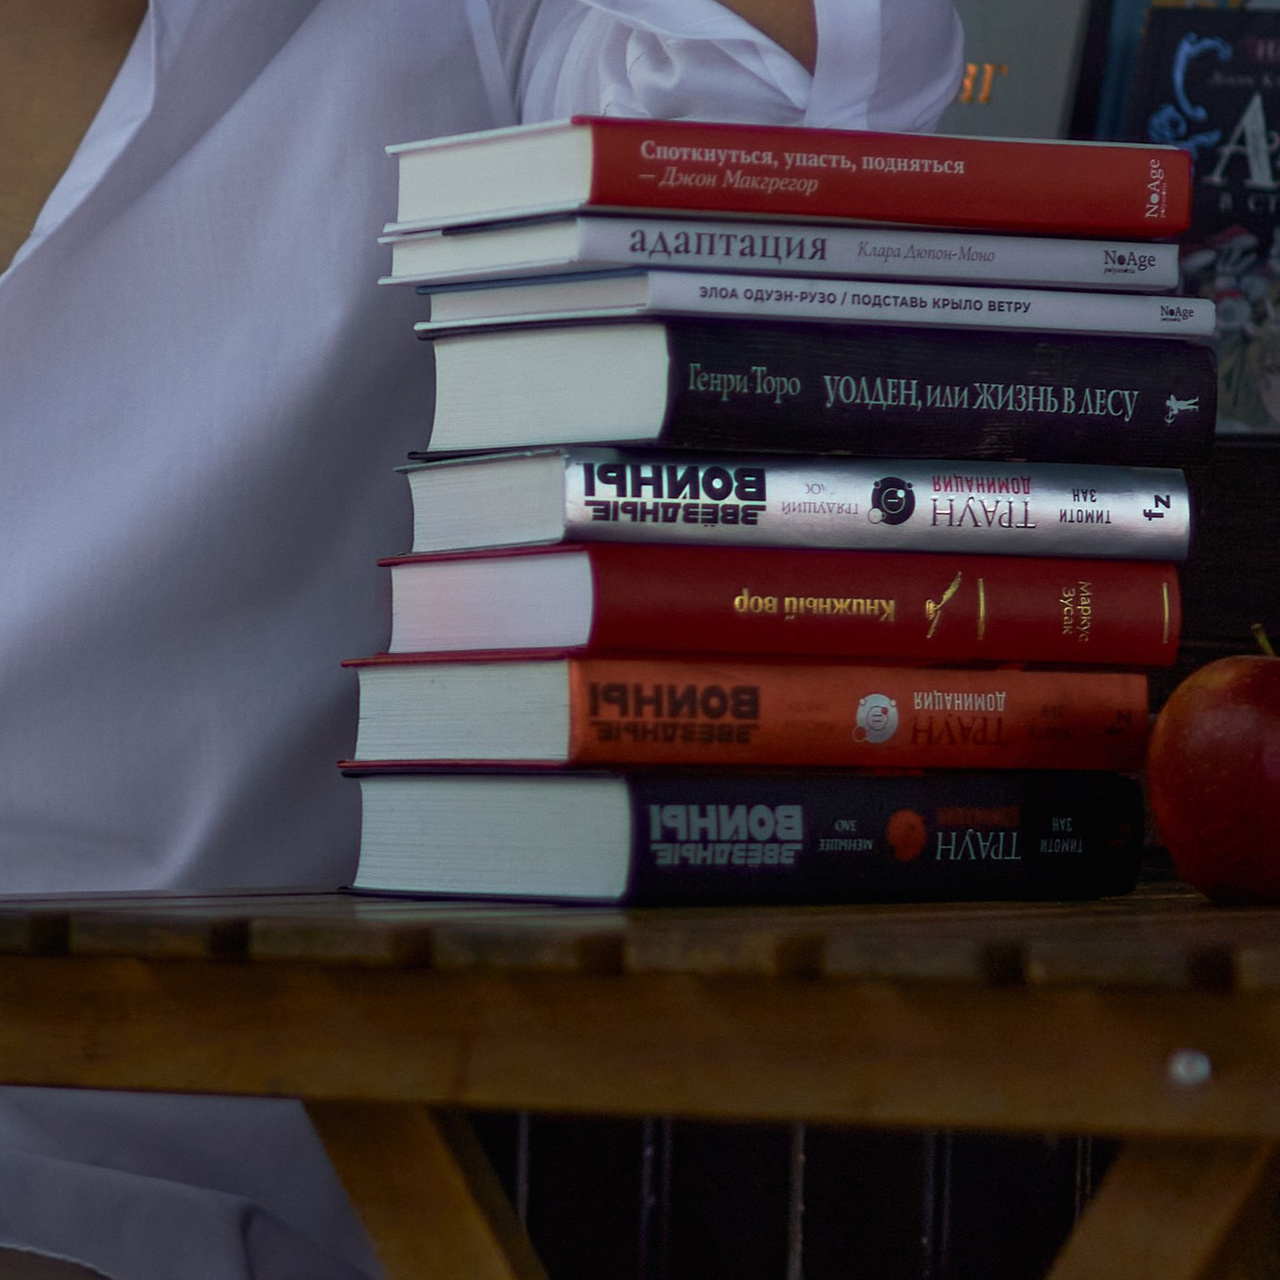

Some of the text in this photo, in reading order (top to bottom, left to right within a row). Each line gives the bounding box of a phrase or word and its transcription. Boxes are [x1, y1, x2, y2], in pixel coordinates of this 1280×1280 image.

[640, 139, 965, 175] Споткнуться, упасть, подняться
[658, 166, 718, 189] Джон
[721, 168, 820, 196] Макгрегор
[629, 229, 828, 264] адаптация
[857, 240, 996, 264] Клара Дюпон-Моно
[699, 286, 739, 300] ЭЛОА
[743, 288, 837, 306] ОДУЭН-РУЗО
[851, 294, 927, 310] ПОДСТАВЬ
[932, 297, 983, 312] КРЫЛО
[988, 300, 1032, 314] ВЕТРУ
[687, 362, 802, 404] Генри Торо
[823, 374, 922, 412] УОЛДЕН,
[972, 382, 1059, 413] ЖИЗНЬ
[1078, 388, 1140, 422] ЛЕСУ
[931, 475, 1031, 495] ДОМИНАЦИЯ
[1072, 488, 1097, 503] ЗАН
[781, 501, 859, 516] ГРЯДУЩИЙ
[930, 494, 1037, 529] ТРАУН
[1059, 508, 1112, 524] ТИМОТИ
[733, 587, 896, 622] Книжный вор
[1059, 586, 1076, 636] Зусак
[1076, 580, 1093, 643] Маркус
[913, 689, 1007, 712] ДОМИНАЦИЯ
[910, 713, 1005, 746] ТРАУН
[1051, 816, 1073, 833] ЗАН
[935, 828, 1022, 861] ТРАУН
[1039, 838, 1084, 854] ТИМОТИ
